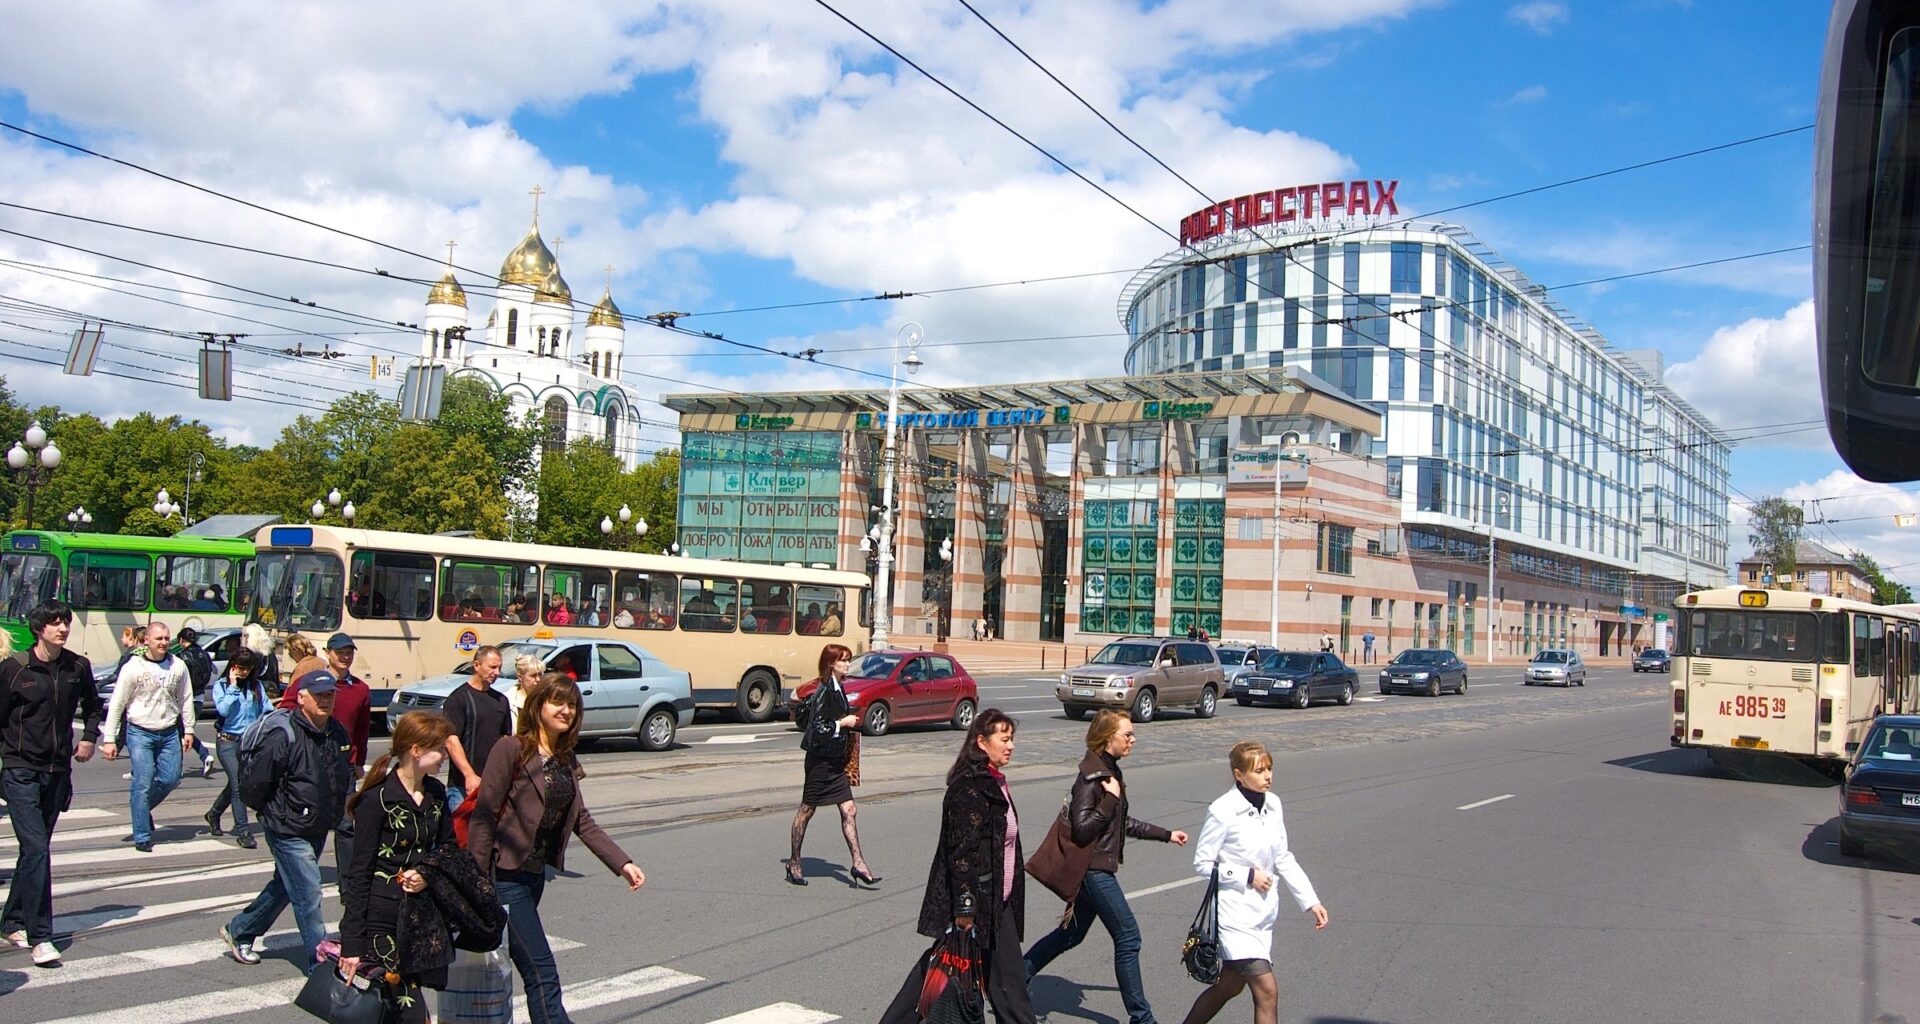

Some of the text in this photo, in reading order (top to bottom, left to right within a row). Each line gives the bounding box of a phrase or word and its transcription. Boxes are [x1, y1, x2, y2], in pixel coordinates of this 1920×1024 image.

[1180, 180, 1399, 247] РОСГОССТРАХ
[378, 364, 391, 376] 145
[878, 406, 1046, 428] ТРГОВЫЙ ЦЕНТР
[748, 472, 806, 489] Клевер
[696, 502, 724, 516] МЫ
[683, 533, 726, 547] ДОБРО
[1748, 596, 1756, 605] 7
[1735, 695, 1769, 718] 985
[1772, 697, 1786, 713] 39
